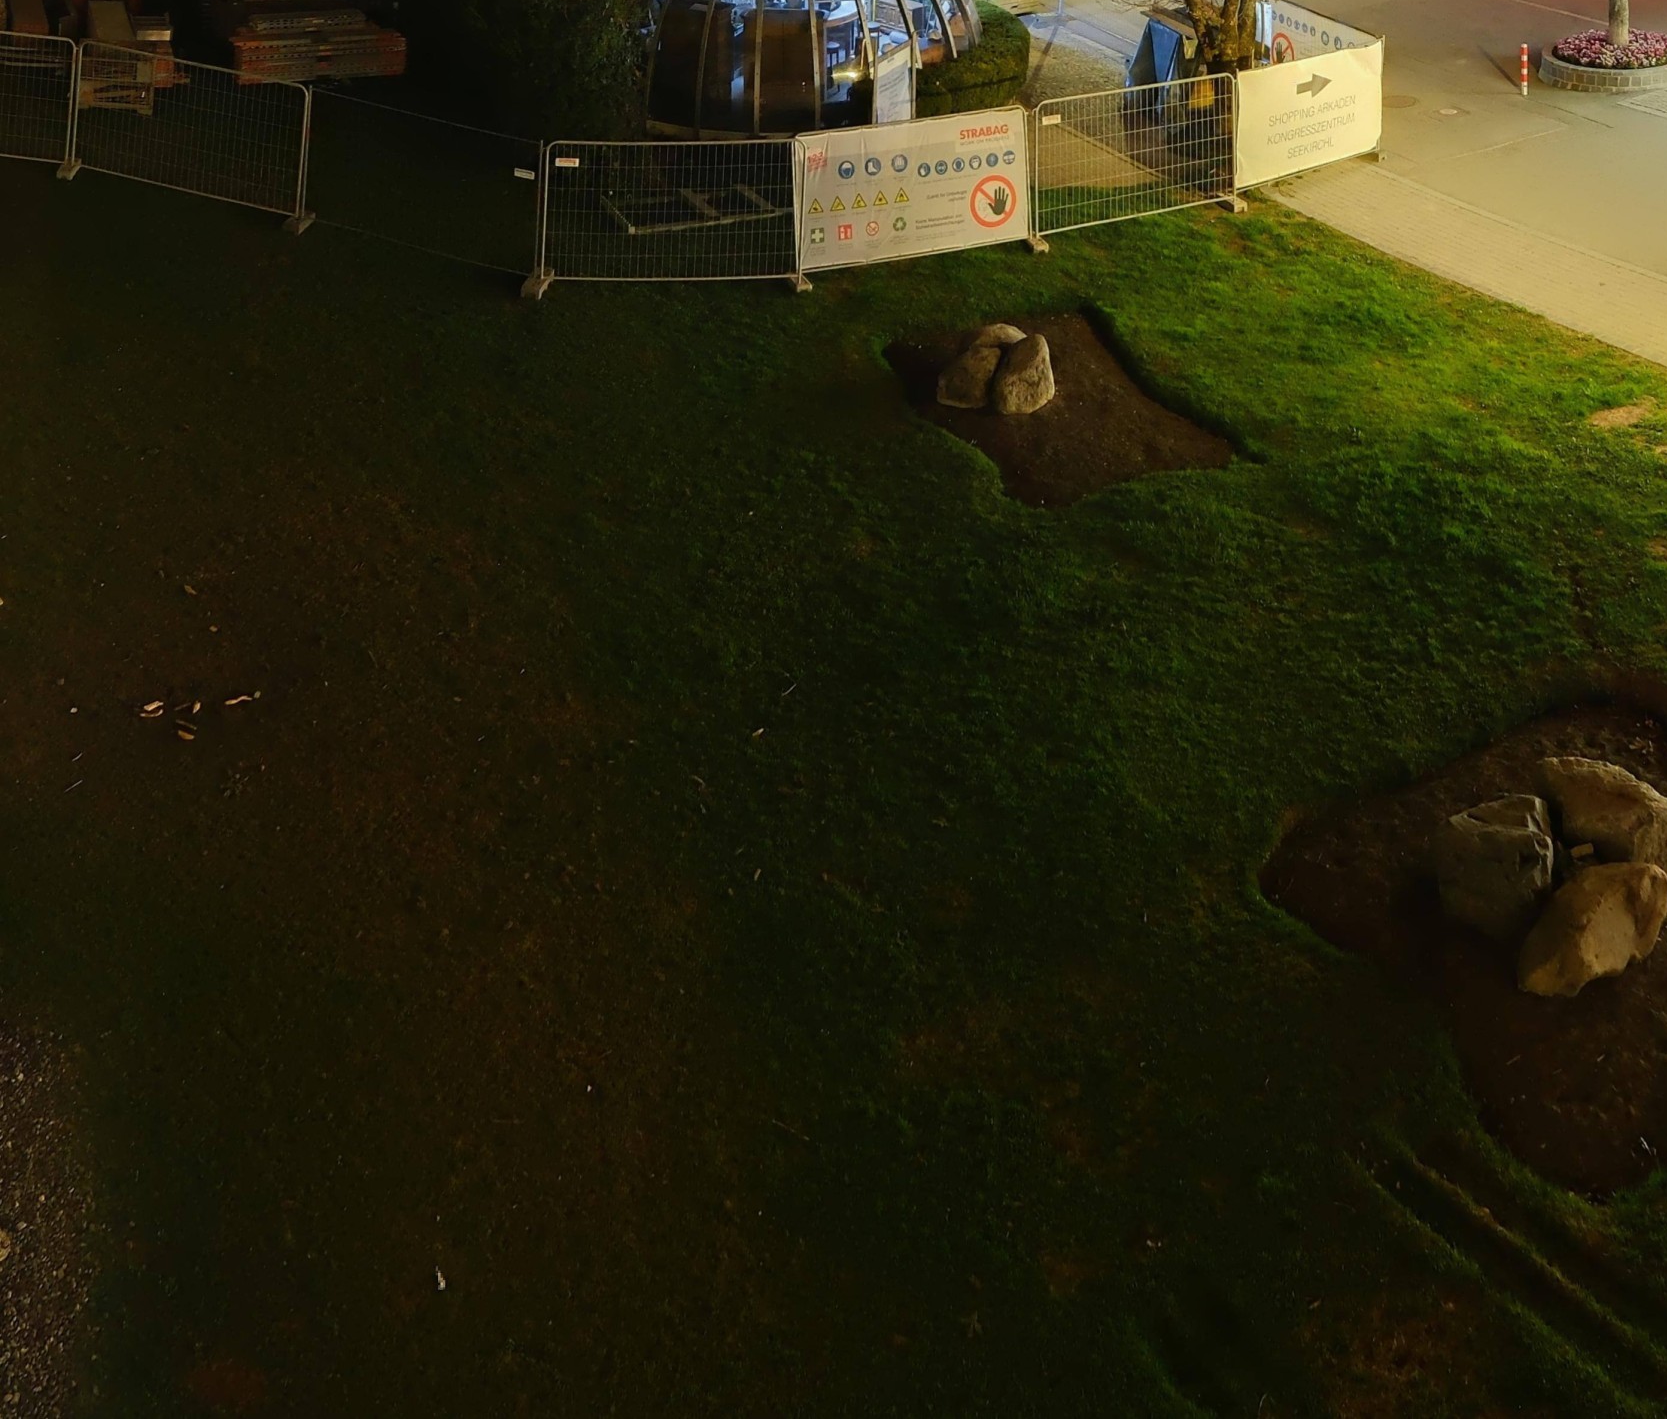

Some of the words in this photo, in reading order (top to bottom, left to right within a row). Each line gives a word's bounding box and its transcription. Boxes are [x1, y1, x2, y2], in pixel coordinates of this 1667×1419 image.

[1268, 106, 1315, 128] SHOPPING
[1317, 94, 1357, 115] ARKADEN
[960, 124, 1009, 140] STRABAG
[1267, 113, 1356, 145] KONGRESSZENTRUM
[1287, 136, 1335, 159] SEEKIRCHL
